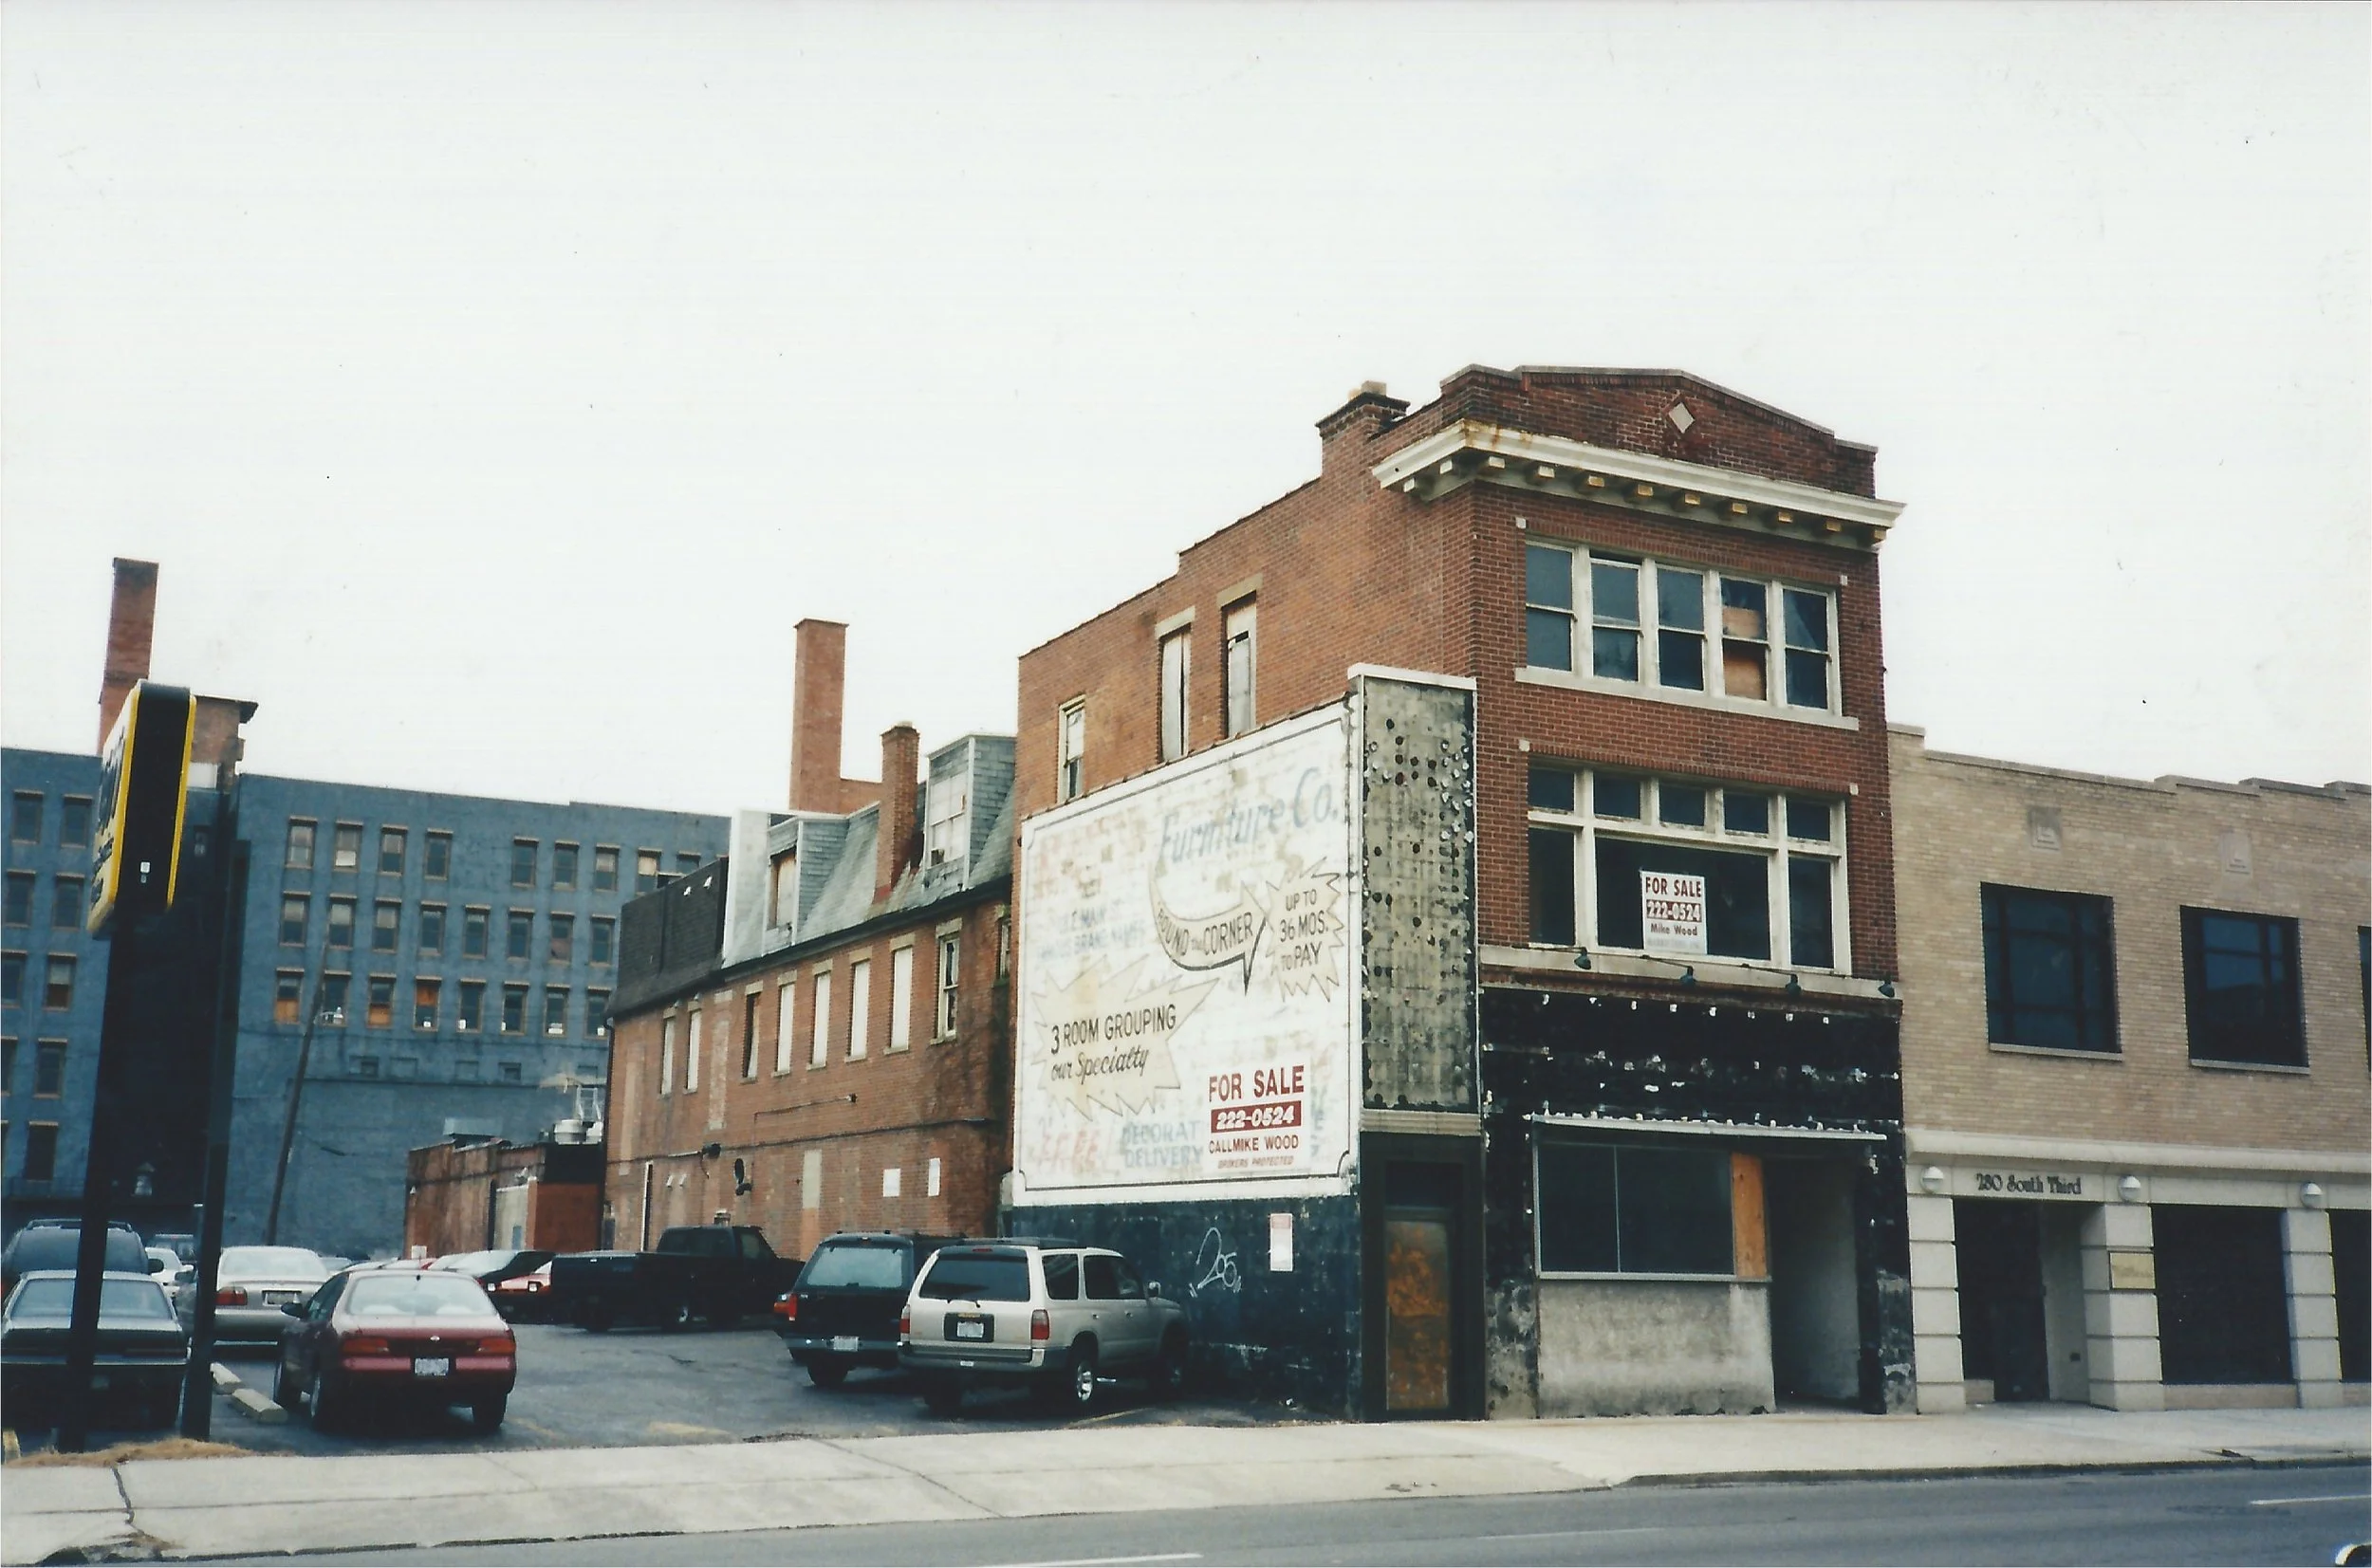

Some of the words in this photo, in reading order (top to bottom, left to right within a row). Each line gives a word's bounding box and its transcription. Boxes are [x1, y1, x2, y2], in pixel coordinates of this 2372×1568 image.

[1645, 876, 1667, 895] FOR
[1674, 879, 1702, 898] SALE
[1285, 893, 1300, 912] UP
[1303, 889, 1318, 908] TO
[1647, 900, 1701, 922] 222-0524
[1203, 912, 1253, 956] CORNER
[1279, 916, 1296, 943] 36
[1298, 910, 1329, 938] MOS.
[1650, 922, 1670, 934] Mike
[1674, 925, 1698, 936] Wood
[1294, 941, 1323, 969] PAY
[1050, 1024, 1061, 1055] 3
[1063, 1018, 1100, 1047] ROOM
[1103, 1004, 1177, 1041] GROUPING
[1051, 1061, 1073, 1081] our
[1075, 1044, 1150, 1085] Specialty
[1209, 1073, 1242, 1102] FOR
[1253, 1064, 1305, 1098] SALE
[1215, 1105, 1295, 1130] 222-0524
[1264, 1134, 1299, 1151] WOOD
[1124, 1145, 1204, 1170] DELIVERY
[2007, 1174, 2044, 1192] South
[2047, 1175, 2082, 1194] Third
